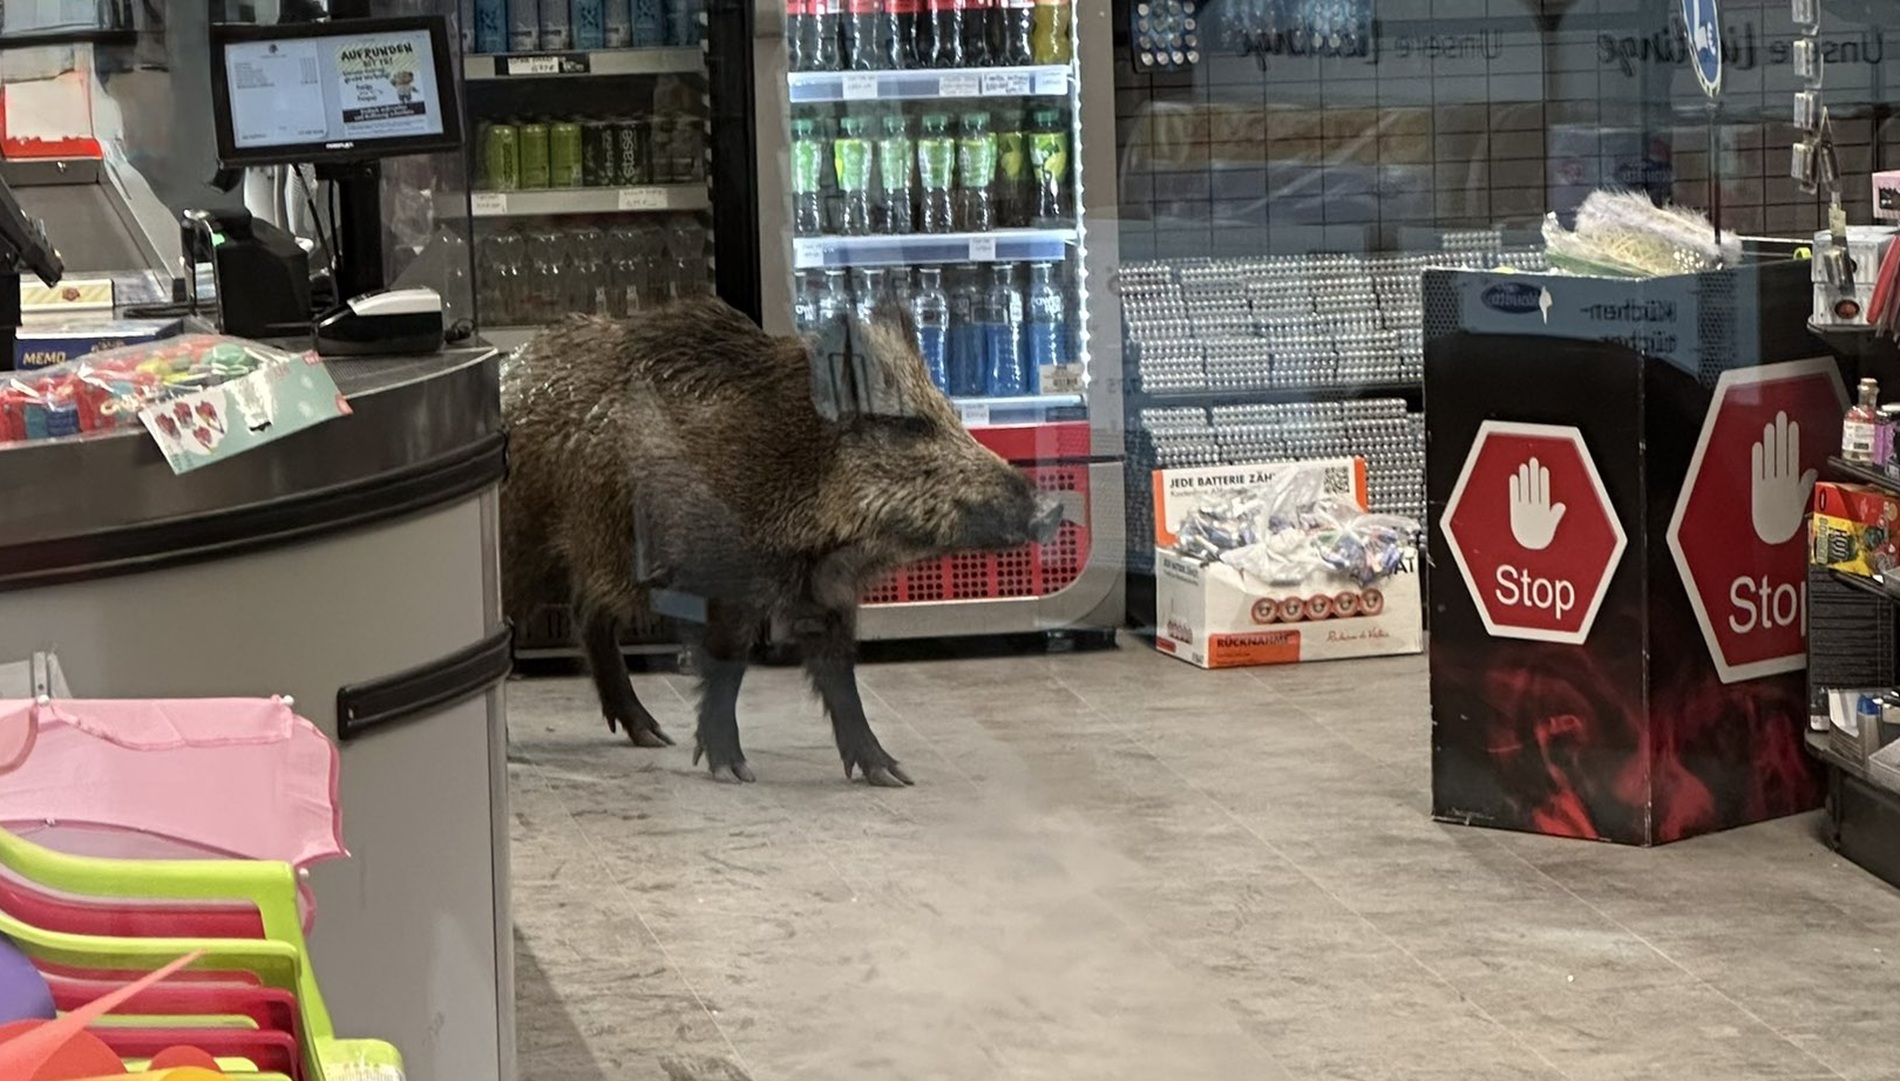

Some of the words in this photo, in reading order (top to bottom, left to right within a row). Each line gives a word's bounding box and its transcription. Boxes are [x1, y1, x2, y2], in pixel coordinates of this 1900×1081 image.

[341, 42, 413, 61] AUFRUNDEN
[22, 351, 67, 365] MEMO
[1170, 478, 1194, 488] JEDE
[1198, 474, 1245, 486] BATTERIE
[1249, 472, 1276, 483] ZÄH
[1392, 556, 1415, 575] AT
[1495, 564, 1575, 620] Stop
